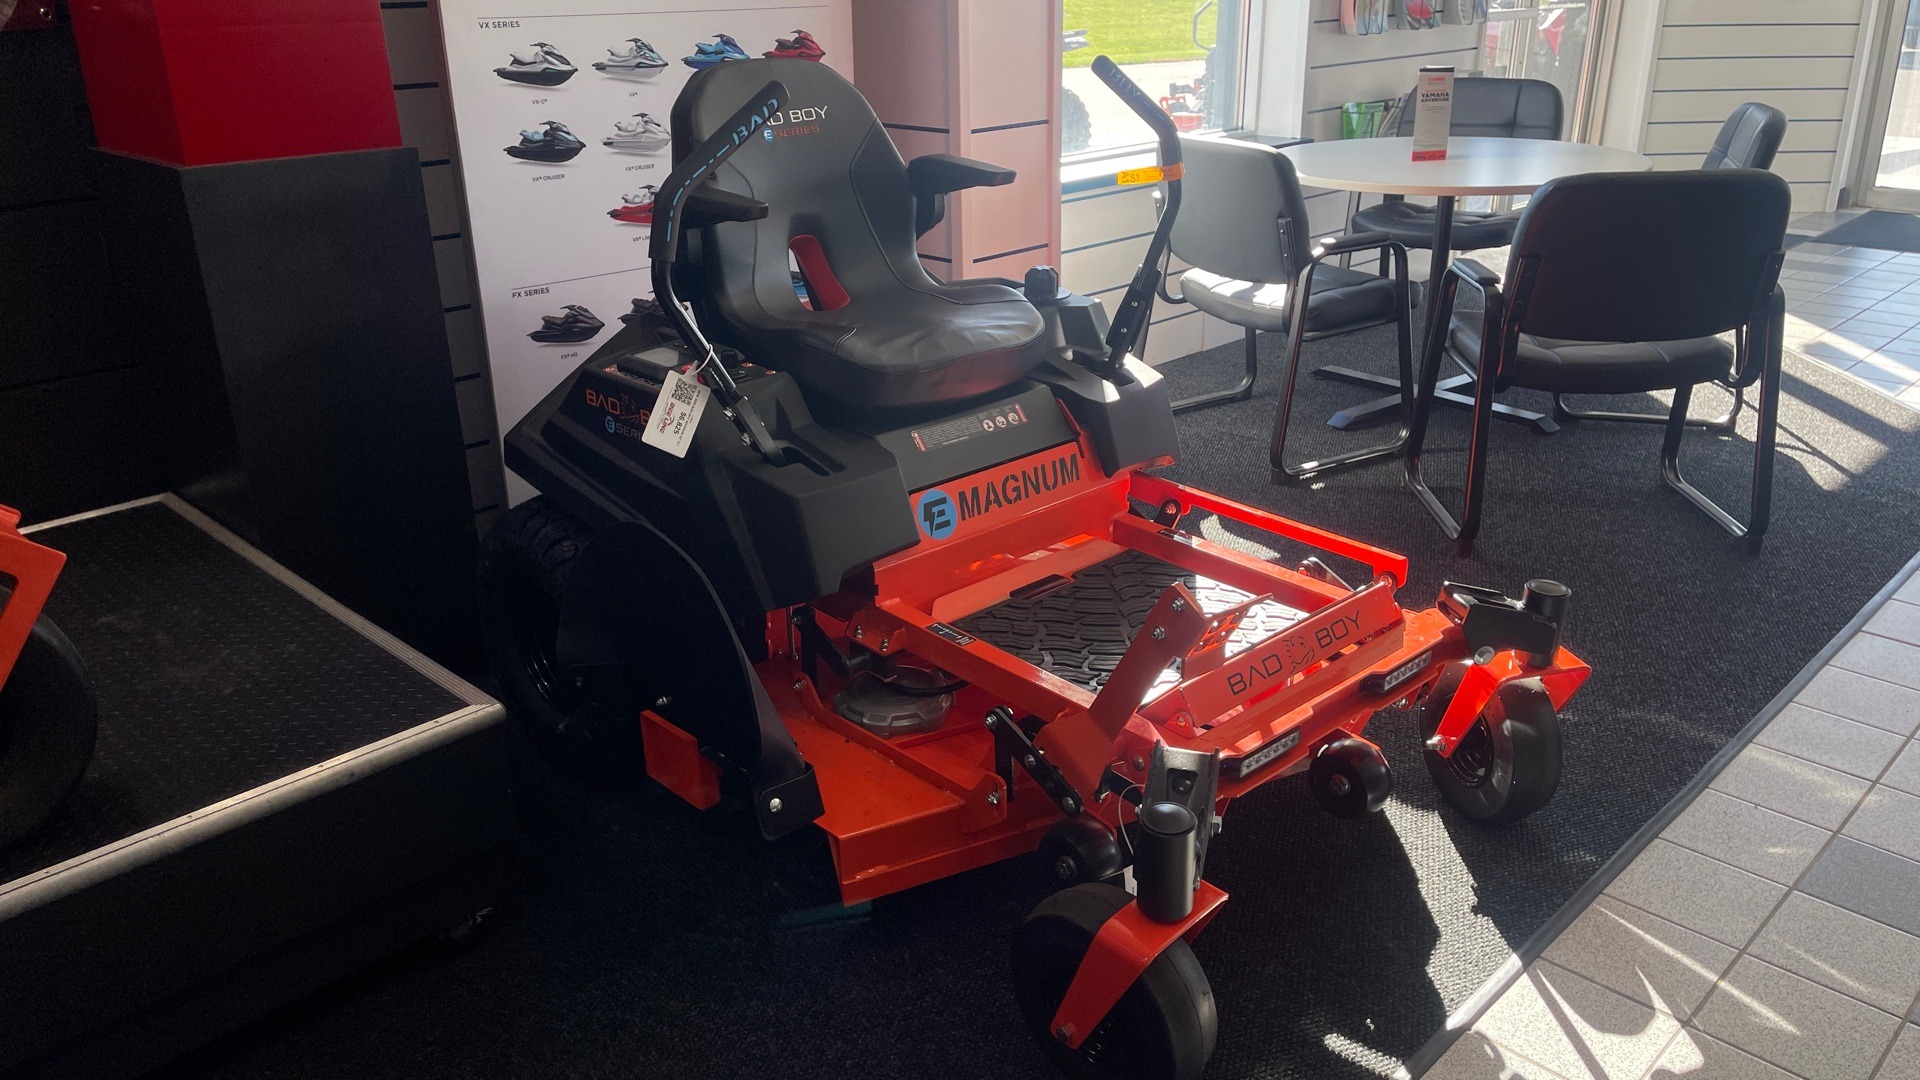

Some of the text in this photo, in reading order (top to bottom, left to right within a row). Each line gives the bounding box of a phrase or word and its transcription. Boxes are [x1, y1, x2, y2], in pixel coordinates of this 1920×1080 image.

[732, 98, 778, 146] BAD
[789, 105, 828, 122] BOY
[774, 125, 820, 138] SERIES
[524, 287, 550, 297] SERIES
[586, 389, 620, 415] BAD
[616, 423, 640, 440] SERI
[673, 411, 687, 435] $6,825
[957, 453, 1081, 521] MAGNUM
[1226, 610, 1362, 696] BAD BOY
